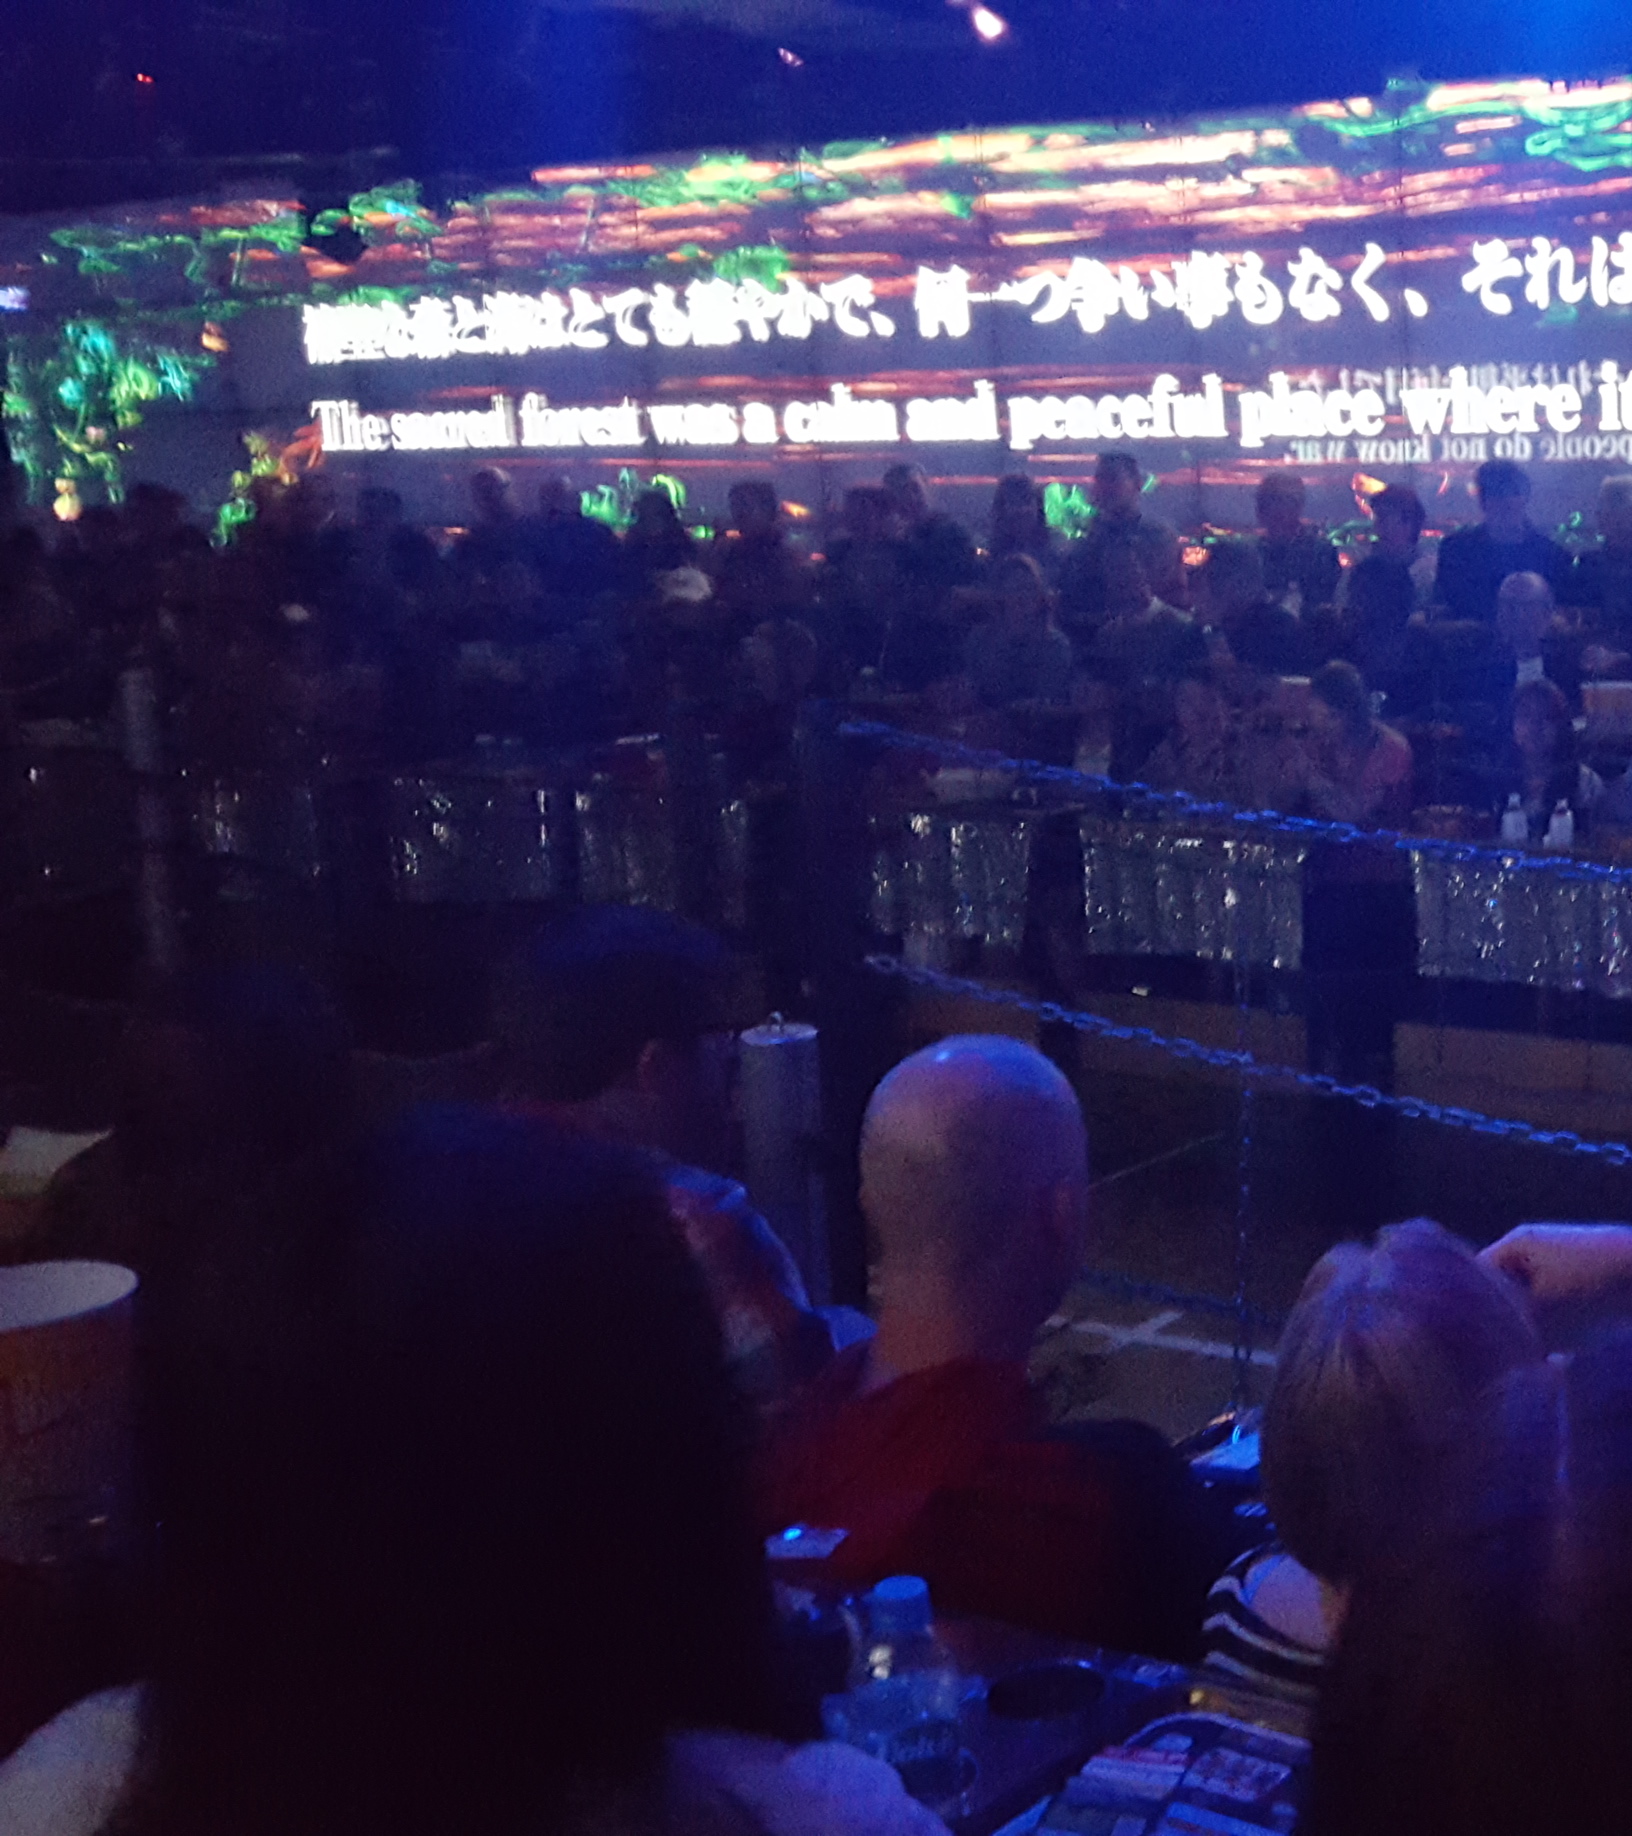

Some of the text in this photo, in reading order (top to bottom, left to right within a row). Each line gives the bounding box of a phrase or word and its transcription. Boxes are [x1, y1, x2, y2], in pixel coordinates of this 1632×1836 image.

[310, 398, 391, 451] The
[518, 392, 646, 447] forest
[646, 402, 744, 445] was
[742, 402, 780, 444] a
[783, 382, 901, 443] calm
[904, 379, 1001, 443] and
[1006, 372, 1230, 451] peaceful
[1237, 370, 1387, 449] place
[1397, 364, 1583, 437] where
